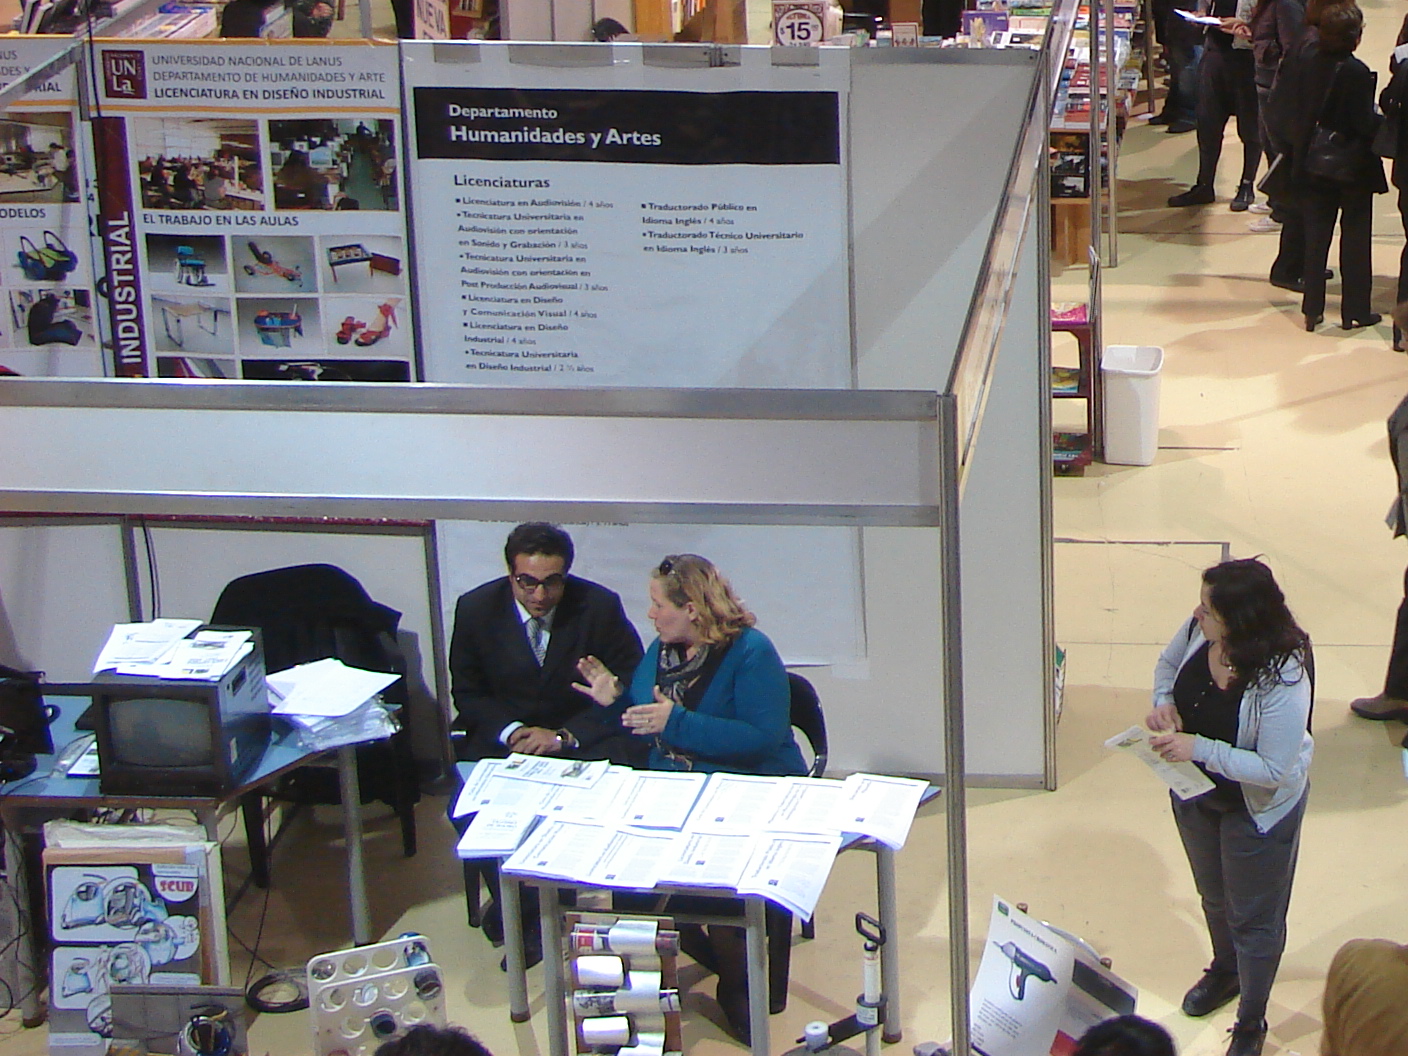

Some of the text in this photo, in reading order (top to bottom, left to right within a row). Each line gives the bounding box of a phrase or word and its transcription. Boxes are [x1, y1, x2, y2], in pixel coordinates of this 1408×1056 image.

[152, 55, 342, 67] UNIVERSIDAD NACIONAL DE LANUS
[153, 71, 241, 83] DEPARTAMENTO
[244, 72, 258, 82] DE
[262, 72, 346, 83] HUMANIDADES
[358, 73, 386, 83] ARTE
[154, 86, 385, 100] LICENCIATURA EN DISEÑO INDUSTRIAL
[448, 104, 558, 120] Departamento
[450, 125, 662, 148] Humanidades y Artes
[454, 175, 550, 188] Licenciaturas
[462, 197, 515, 207] Licenciatura
[531, 198, 582, 208] Audiovisión
[649, 202, 709, 211] Traductorado
[711, 203, 744, 212] Público
[143, 213, 299, 227] EL TRABAJO EN LAS AULAS
[642, 217, 702, 226] Idioma Inglés
[648, 231, 804, 240] Traductorado Técnico Universitario
[105, 211, 142, 364] INDUSTRIAL
